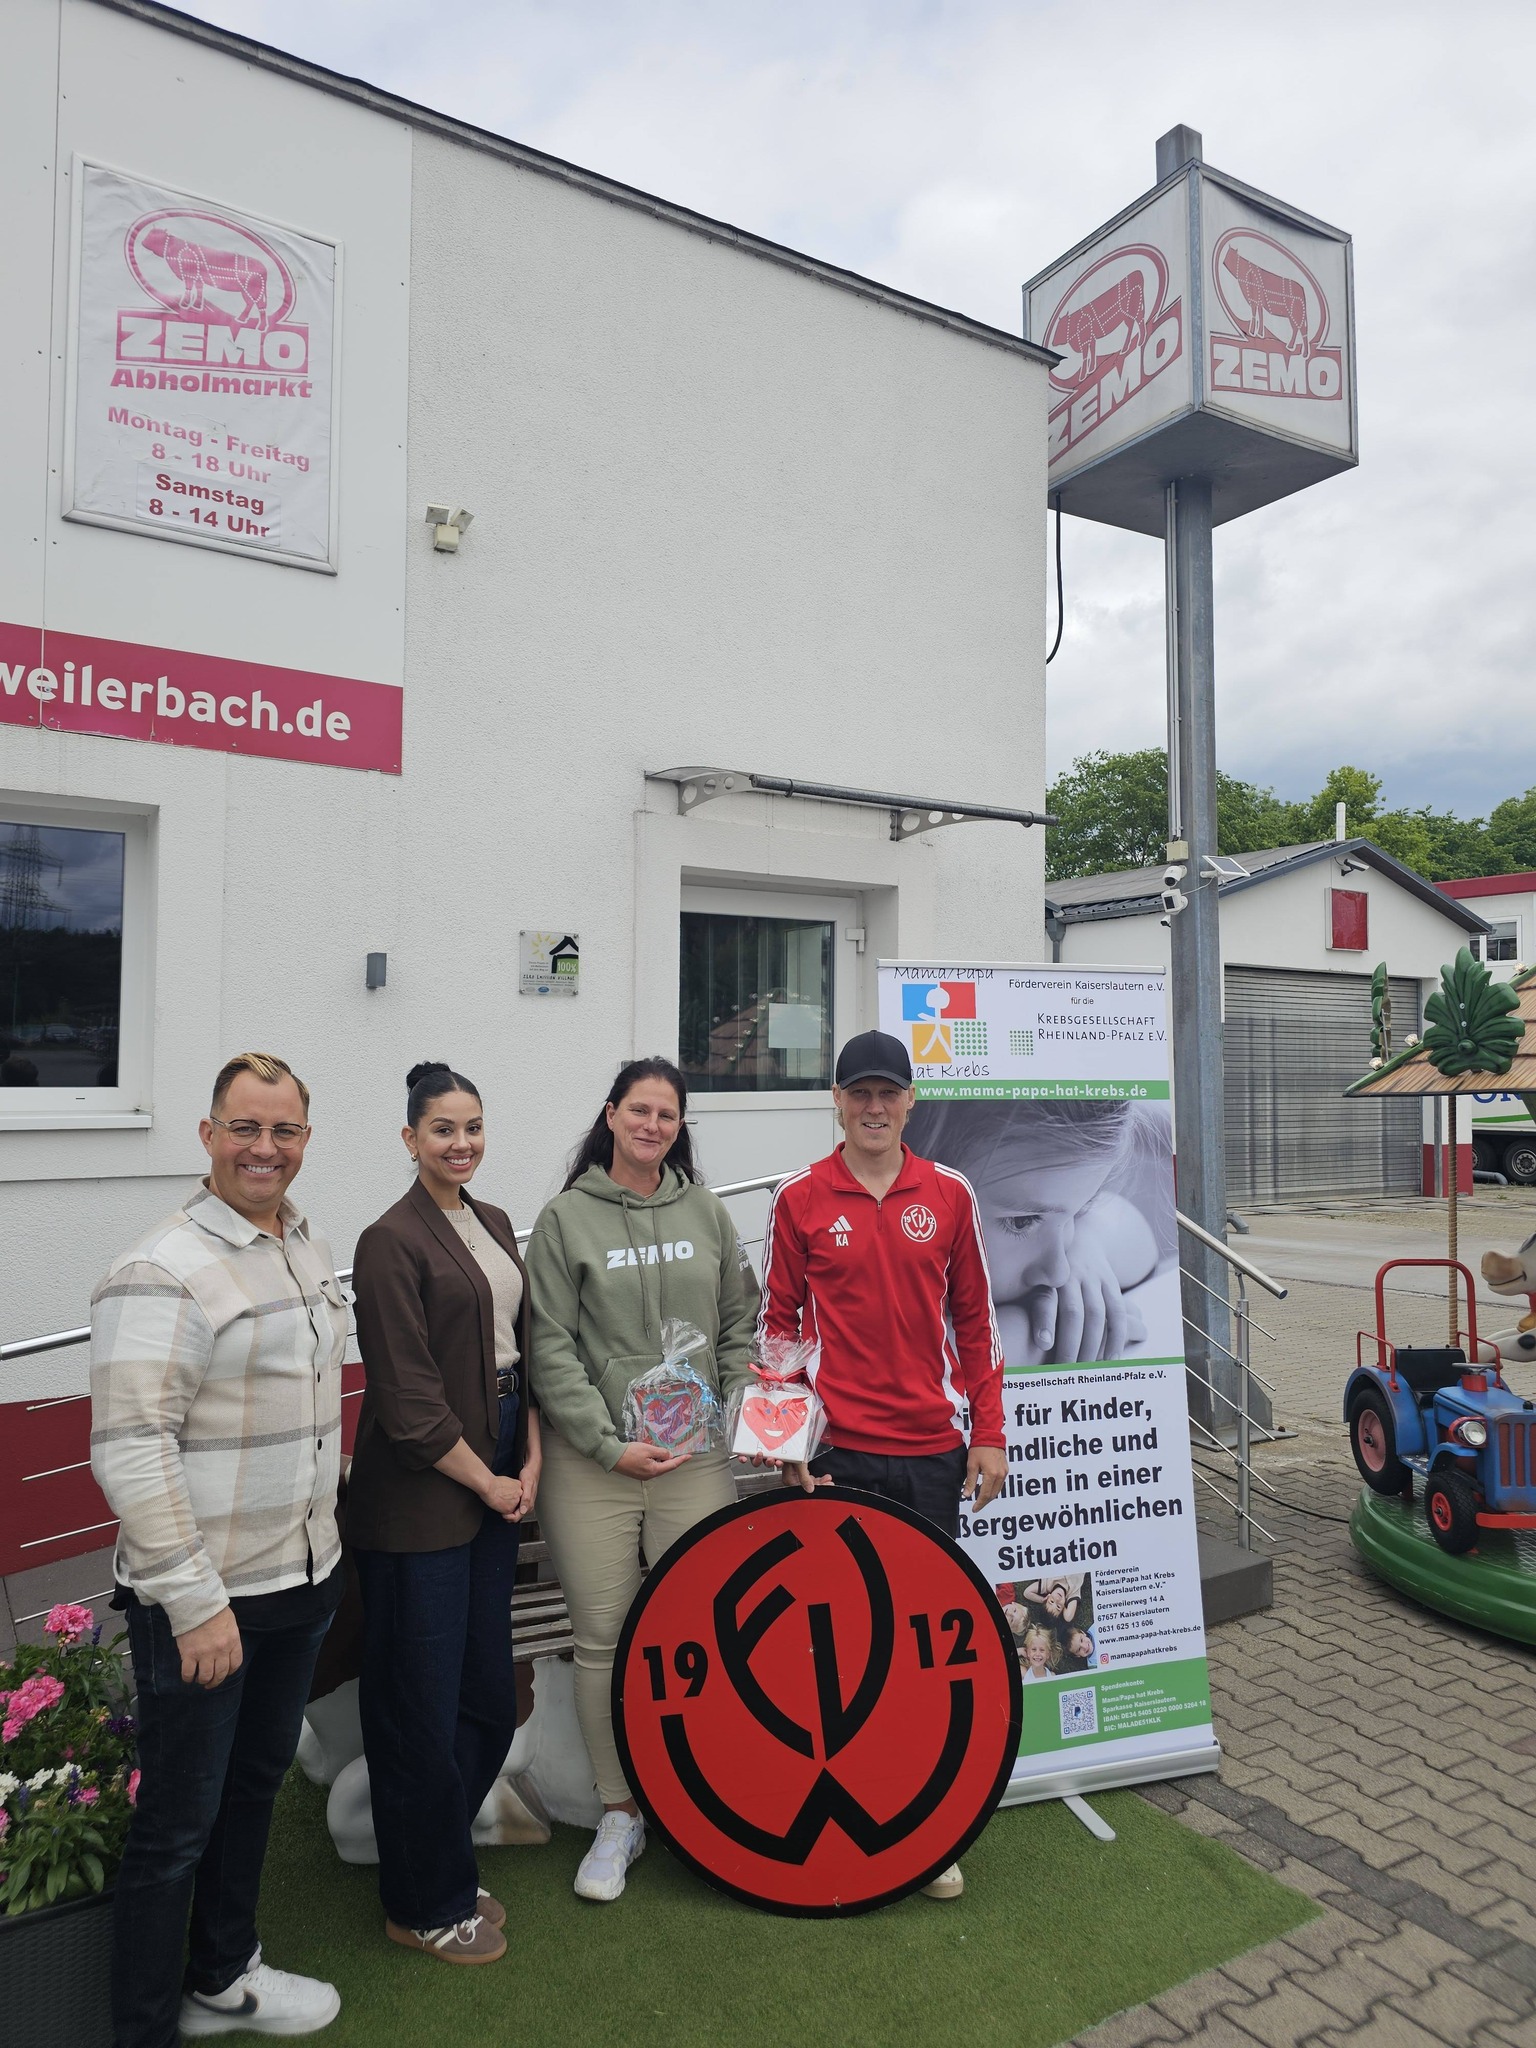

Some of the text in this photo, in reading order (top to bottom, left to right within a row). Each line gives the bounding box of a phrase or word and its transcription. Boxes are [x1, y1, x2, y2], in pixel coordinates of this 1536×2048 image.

[119, 316, 306, 369] ZEMO
[110, 369, 312, 398] Abholmarkt
[1048, 316, 1181, 446] ZEMO
[1214, 343, 1340, 398] ZEMO
[107, 406, 203, 447] Montag
[227, 435, 310, 472] Freitag
[151, 443, 165, 460] 8
[191, 453, 219, 472] 18
[229, 462, 271, 484] Uhr
[155, 473, 264, 516] Samstag
[149, 499, 163, 516] 8
[190, 508, 218, 527] 14
[228, 515, 270, 538] Uhr
[1009, 979, 1165, 991] Förderverein Kaiserslautern e.V.
[1071, 997, 1094, 1005] für die
[941, 1061, 990, 1078] Krebs
[919, 1083, 1148, 1099] www.mama-papa-hat-krebs.de
[835, 1233, 849, 1247] KA
[606, 1240, 694, 1270] ZEMO
[1002, 1371, 1167, 1390] ebsgesellschaft Rheinland-Pfalz e.V.
[1015, 1404, 1052, 1427] für
[1061, 1397, 1152, 1422] Kinder,
[1008, 1427, 1158, 1463] ndliche und
[1066, 1469, 1089, 1492] in
[1097, 1465, 1163, 1488] einer
[957, 1498, 1183, 1541] ßergewöhnlichen
[998, 1538, 1118, 1571] Situation
[1095, 1566, 1139, 1577] Förderverein
[1153, 1571, 1176, 1580] Krebs
[1096, 1586, 1147, 1597] Kaiserslautern
[1097, 1598, 1147, 1610] Gersweilerweg
[1119, 1606, 1170, 1619] Kaiserslautern
[1099, 1625, 1201, 1645] www.mama-papa-hat-krebs.de
[642, 1640, 709, 1701] 19
[909, 1608, 978, 1670] 12
[1110, 1645, 1178, 1660] mamapapahatkrebs
